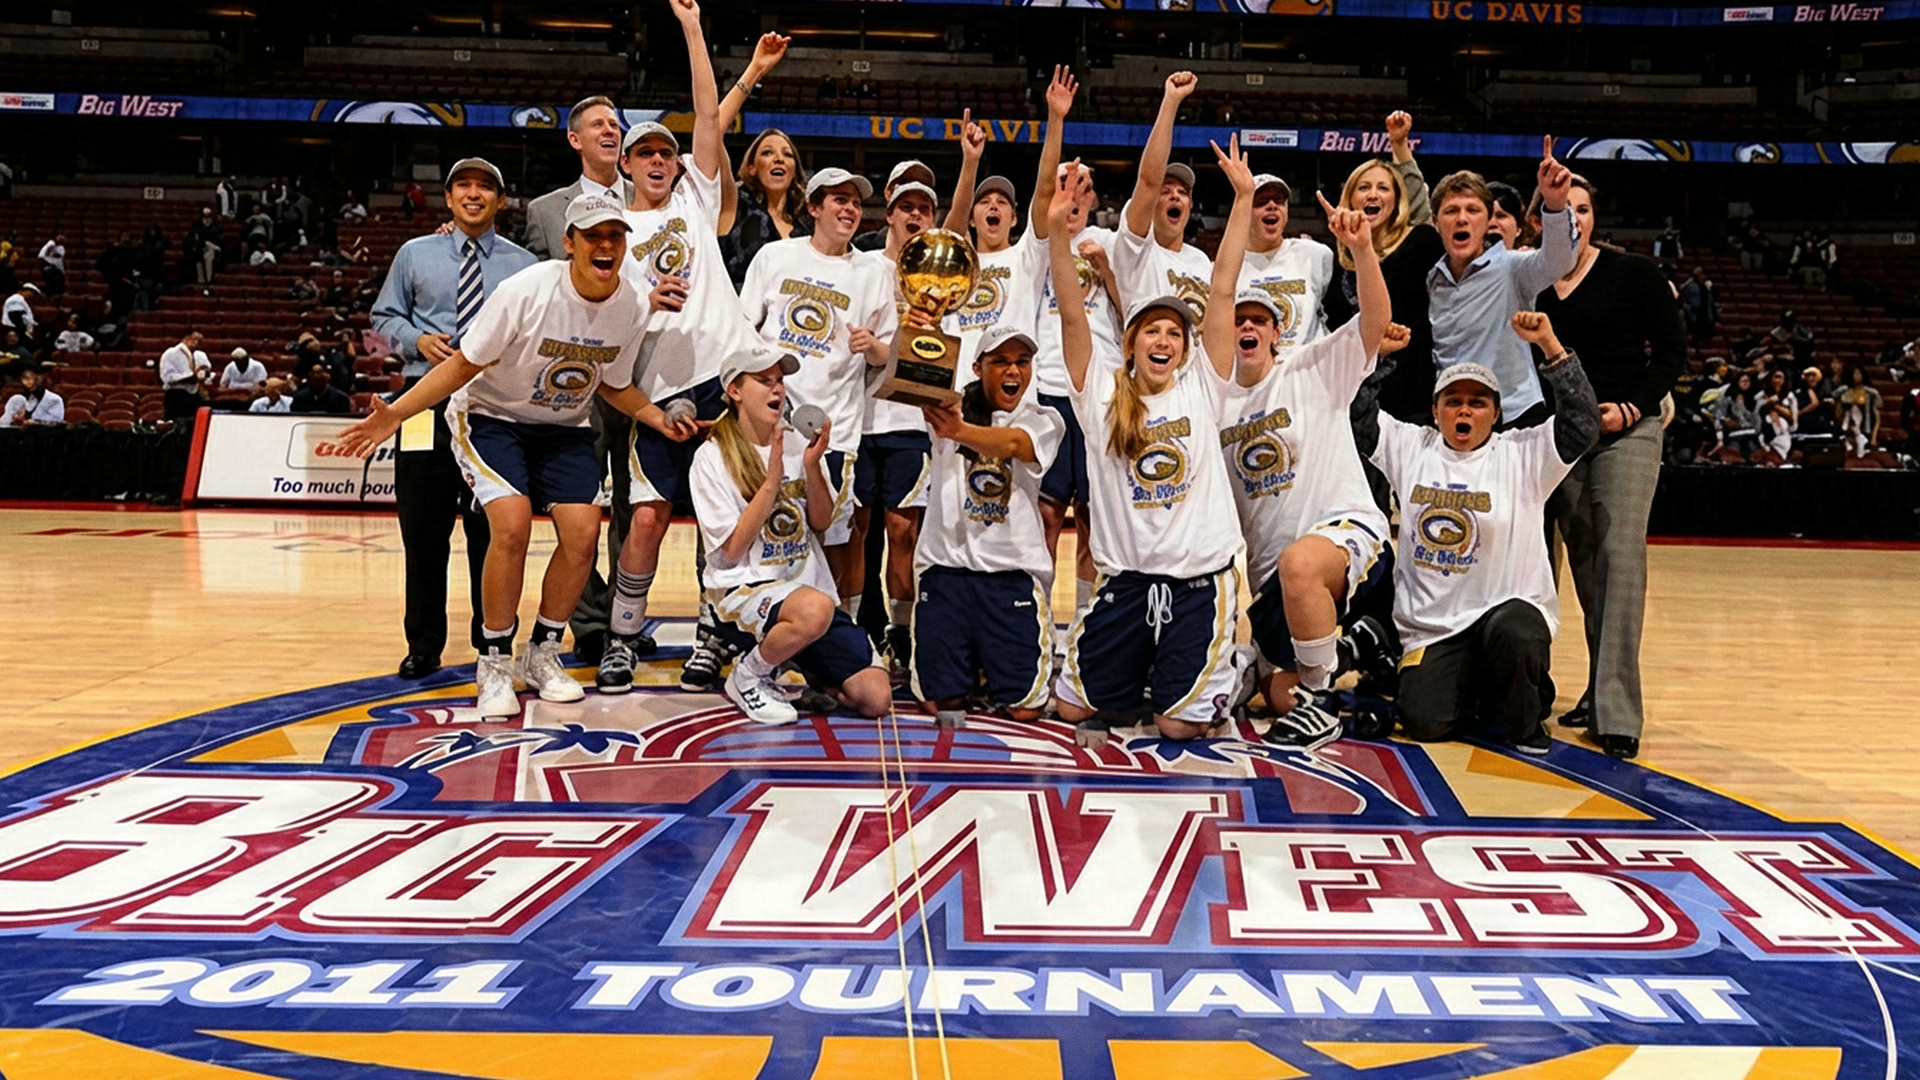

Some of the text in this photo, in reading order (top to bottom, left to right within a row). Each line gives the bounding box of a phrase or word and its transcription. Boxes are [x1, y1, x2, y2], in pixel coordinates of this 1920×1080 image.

[1432, 1, 1582, 24] UC DAVIS
[870, 116, 1041, 143] UC DAVI
[273, 477, 303, 493] Too
[307, 479, 355, 494] much
[46, 959, 1750, 1022] 2011 TOURNAMENT
